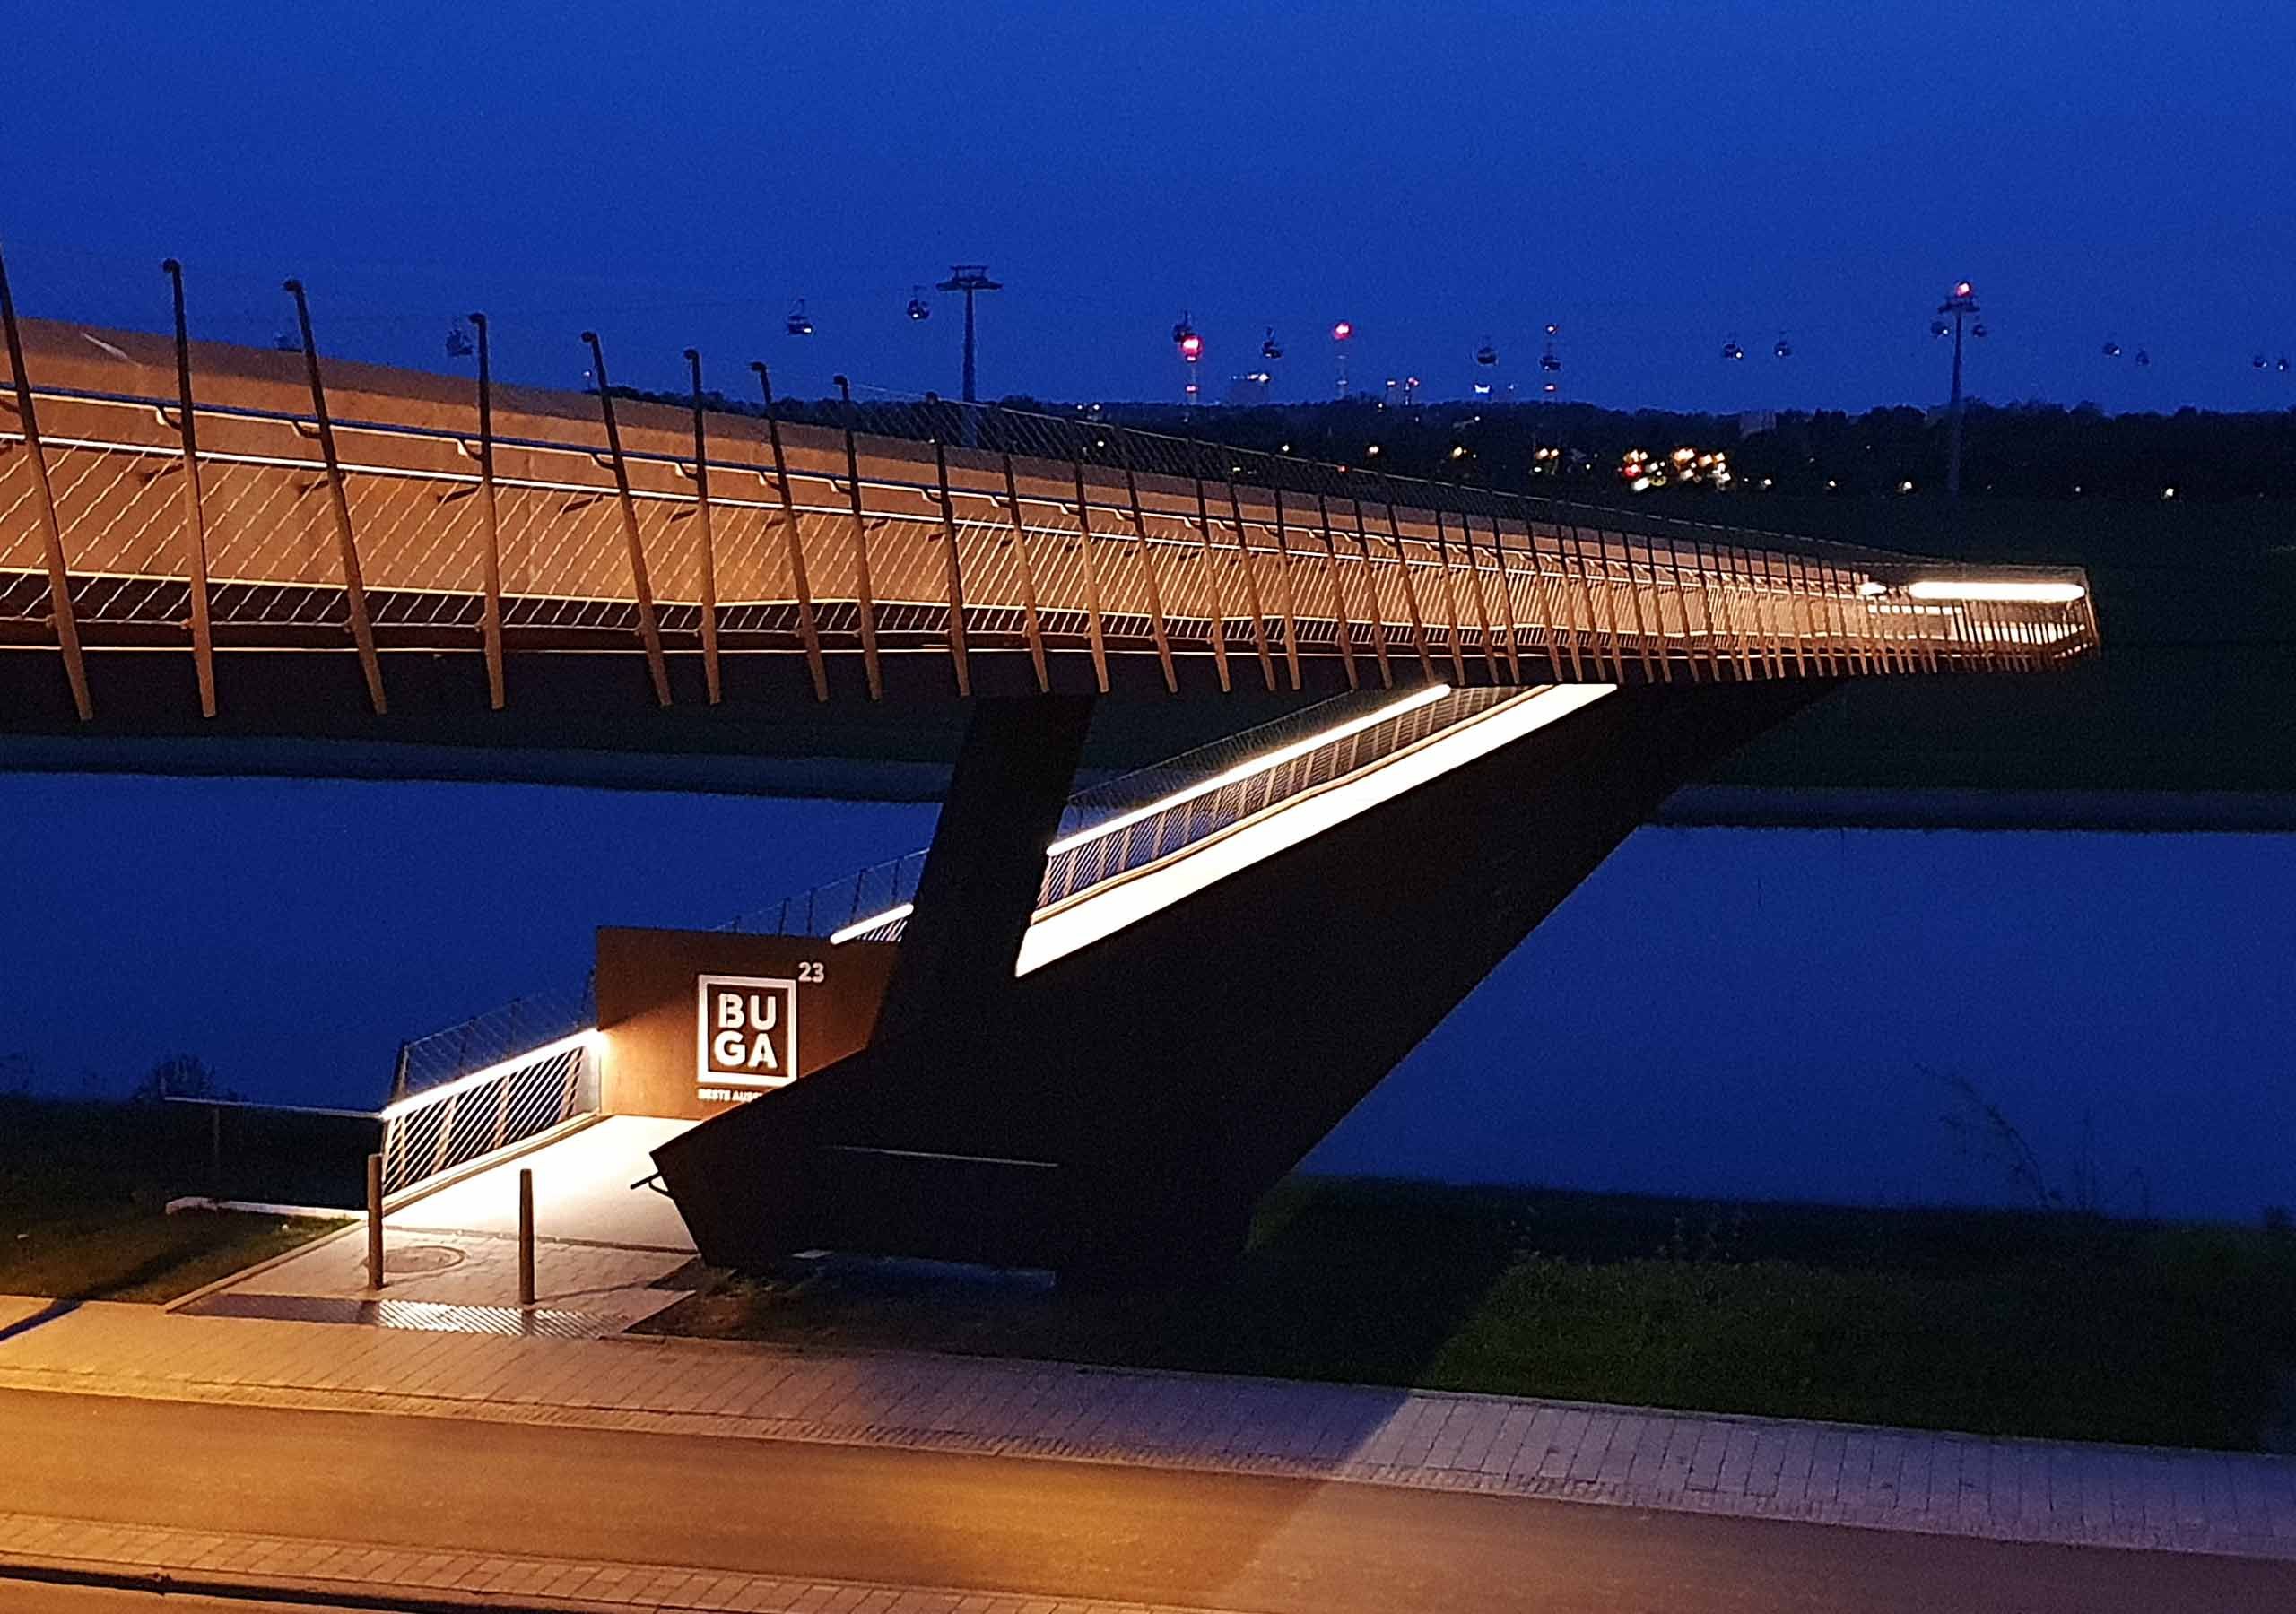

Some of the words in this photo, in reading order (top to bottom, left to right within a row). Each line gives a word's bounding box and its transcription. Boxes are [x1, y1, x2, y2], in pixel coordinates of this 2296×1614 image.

[798, 962, 825, 983] 23
[718, 993, 776, 1031] BU
[714, 1030, 778, 1069] GA
